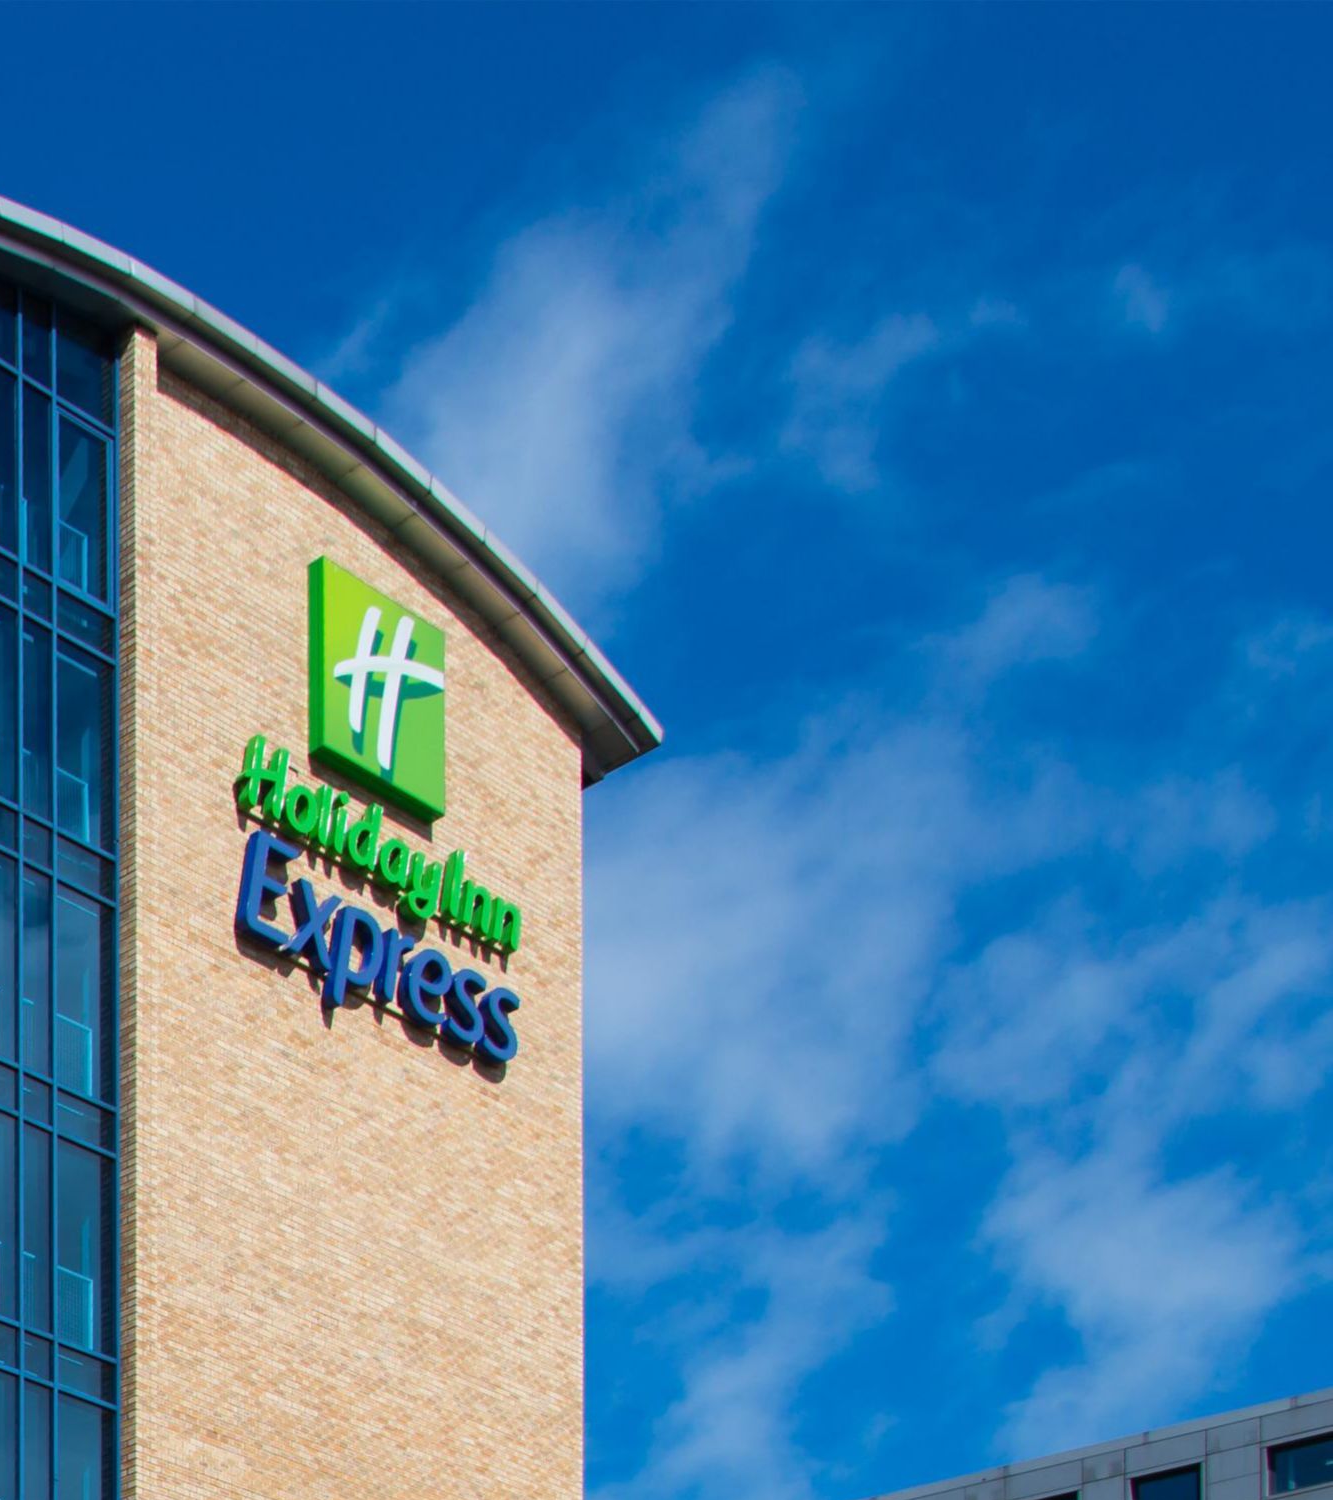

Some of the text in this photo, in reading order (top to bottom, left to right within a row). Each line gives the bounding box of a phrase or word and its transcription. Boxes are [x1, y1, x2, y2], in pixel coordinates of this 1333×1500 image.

[233, 733, 522, 954] Holiday Inn
[233, 829, 522, 1064] Express
